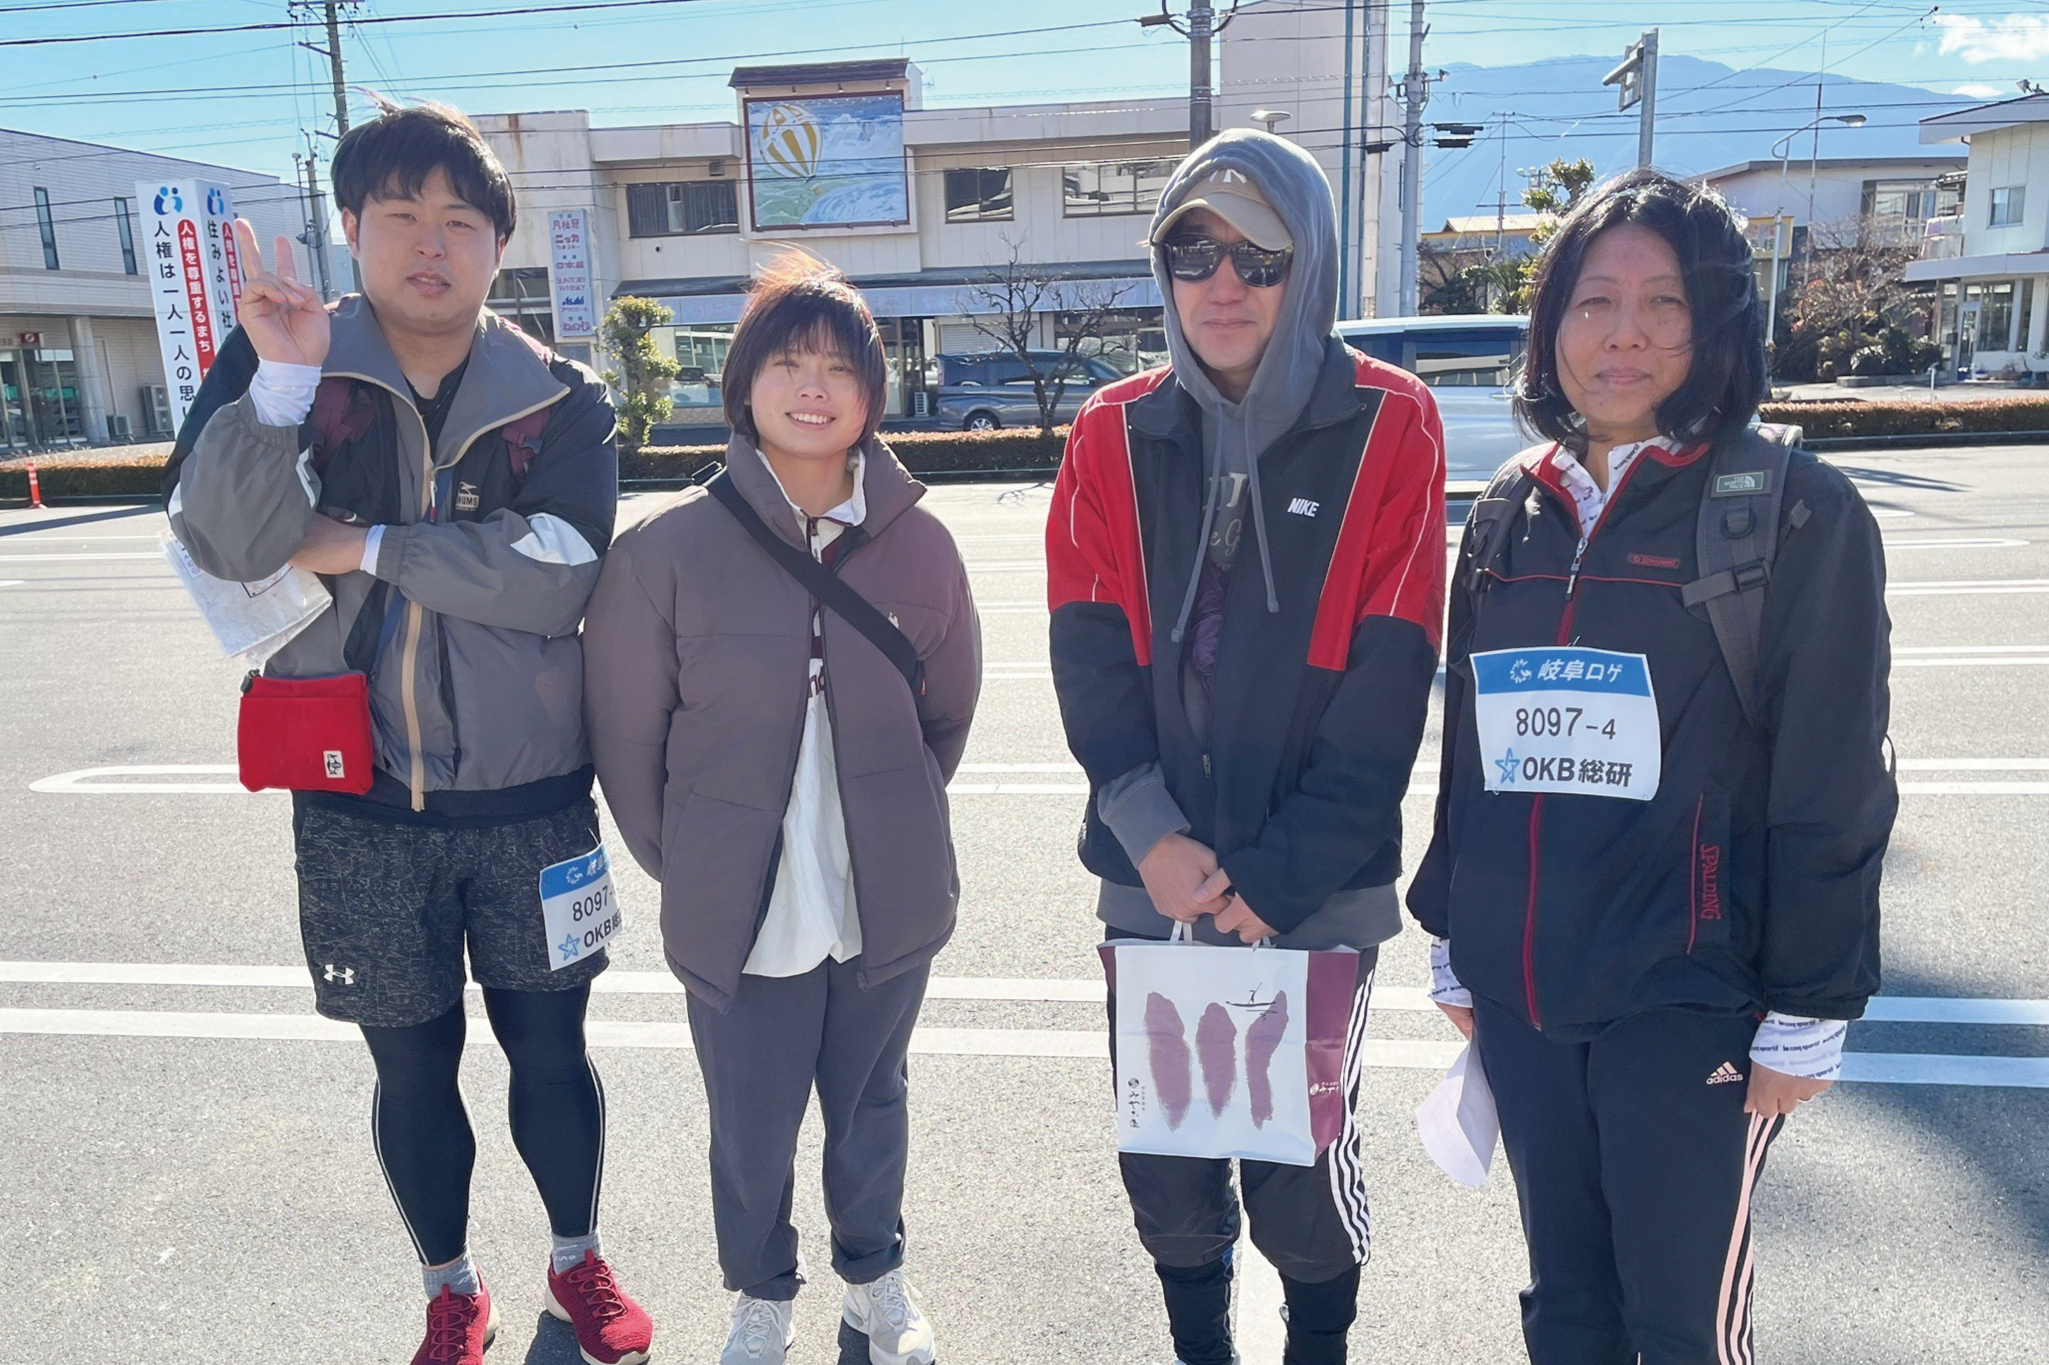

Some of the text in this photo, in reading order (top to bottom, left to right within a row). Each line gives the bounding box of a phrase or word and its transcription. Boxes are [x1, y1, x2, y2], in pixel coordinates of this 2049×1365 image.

[456, 495, 478, 506] HUMS
[1287, 498, 1320, 517] NIKE
[1537, 659, 1623, 682] 岐阜ロゲ
[1515, 707, 1616, 740] 8097-4
[1522, 757, 1633, 787] OKB総研
[1701, 843, 1720, 919] SPALDING
[1706, 1073, 1743, 1085] adidas
